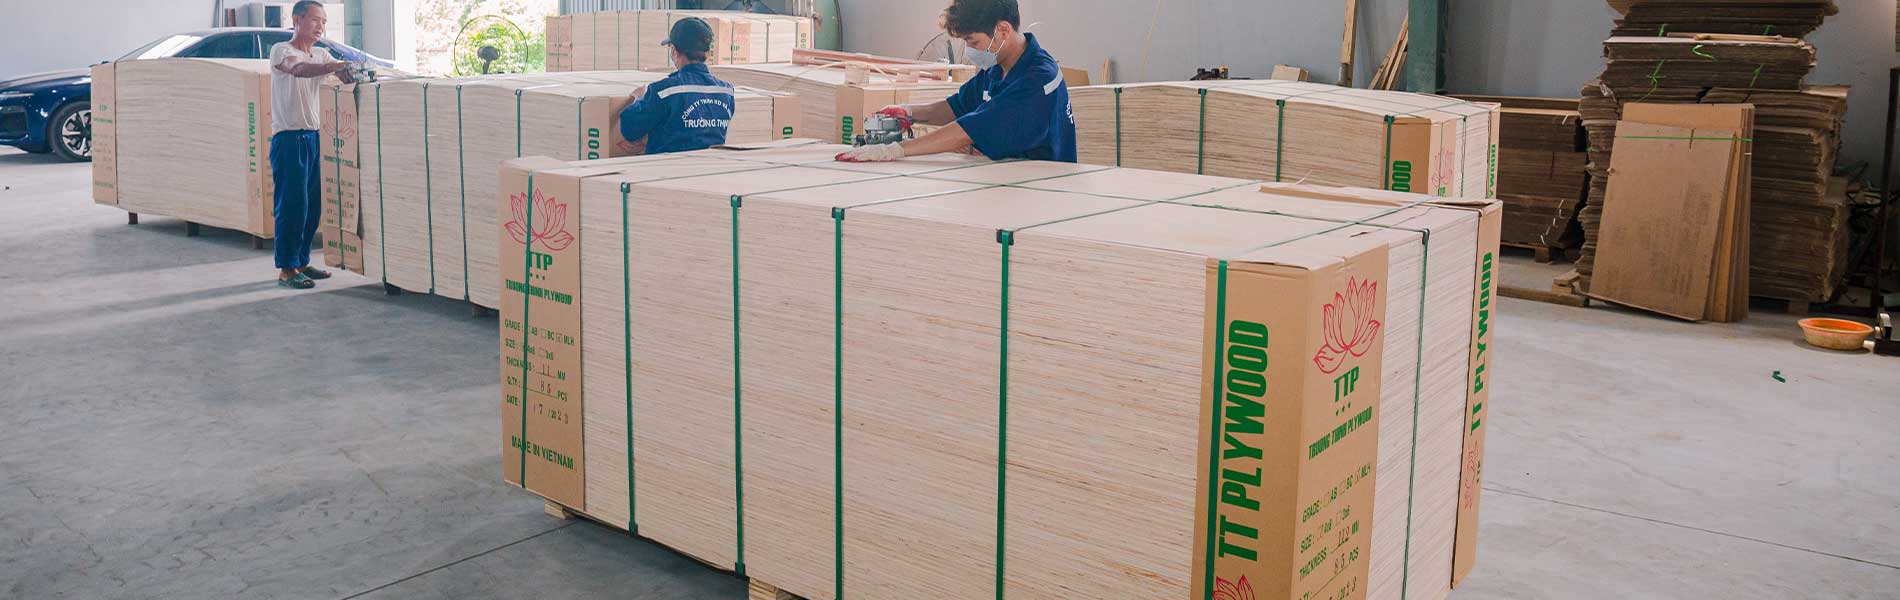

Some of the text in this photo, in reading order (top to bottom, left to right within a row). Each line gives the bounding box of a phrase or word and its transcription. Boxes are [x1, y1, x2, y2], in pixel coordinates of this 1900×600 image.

[544, 289, 573, 305] PLYWOOD
[1473, 252, 1493, 394] PLYWOOD
[1334, 366, 1359, 403] TTP
[511, 435, 532, 454] MAE
[541, 446, 574, 470] VIETNAM
[1218, 320, 1269, 562] TT PLYWOOD
